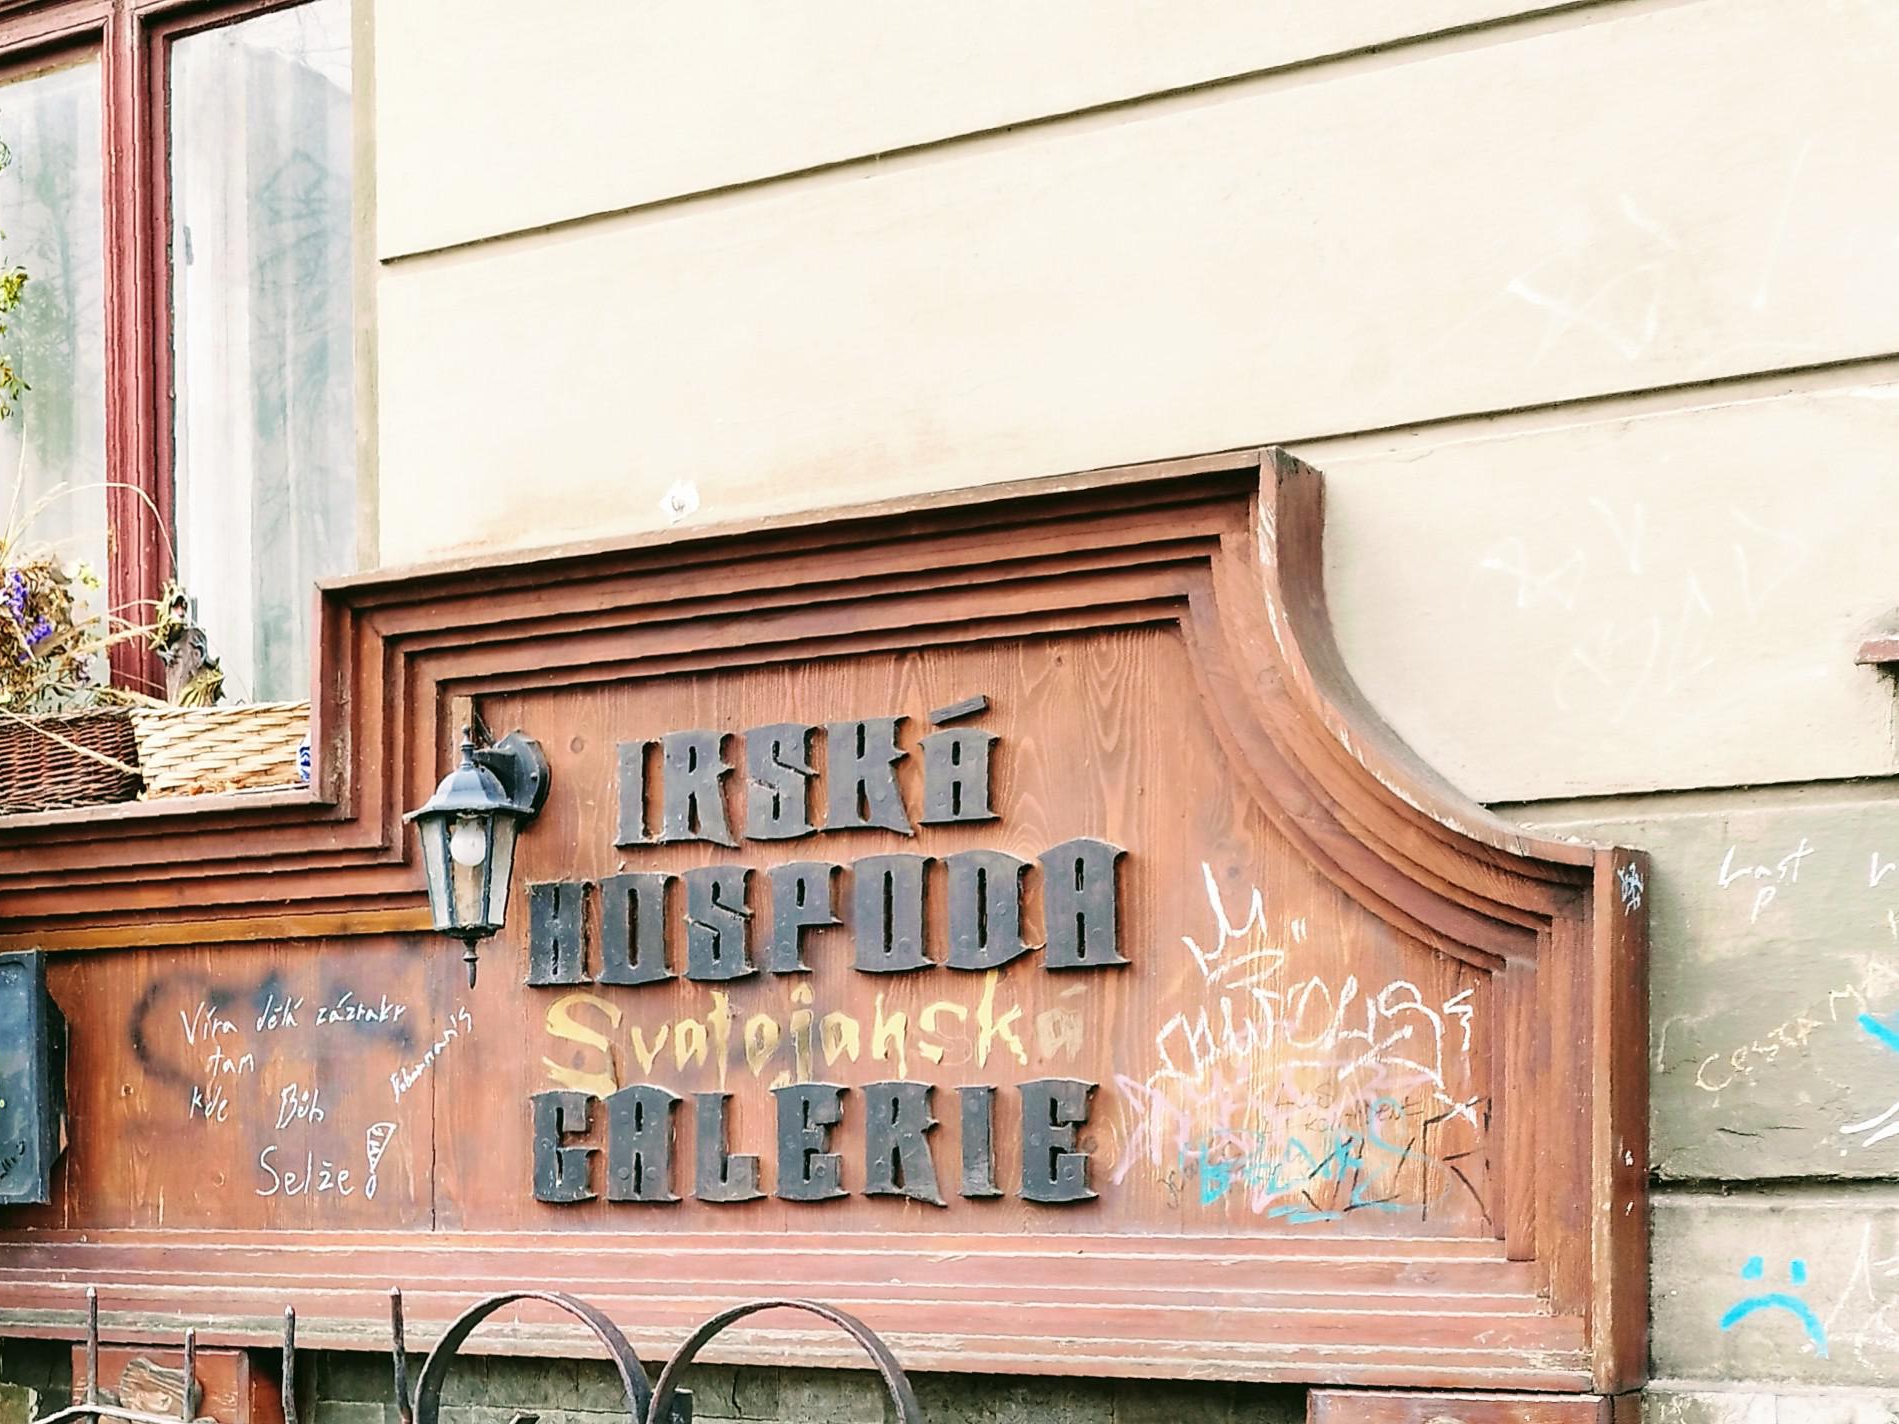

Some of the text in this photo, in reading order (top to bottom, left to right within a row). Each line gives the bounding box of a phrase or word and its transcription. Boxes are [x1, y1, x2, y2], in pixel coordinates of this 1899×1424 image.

[615, 694, 1000, 848] IRSKÁ
[525, 837, 1132, 987] HOSPODA
[530, 1078, 1099, 1207] GALERIE
